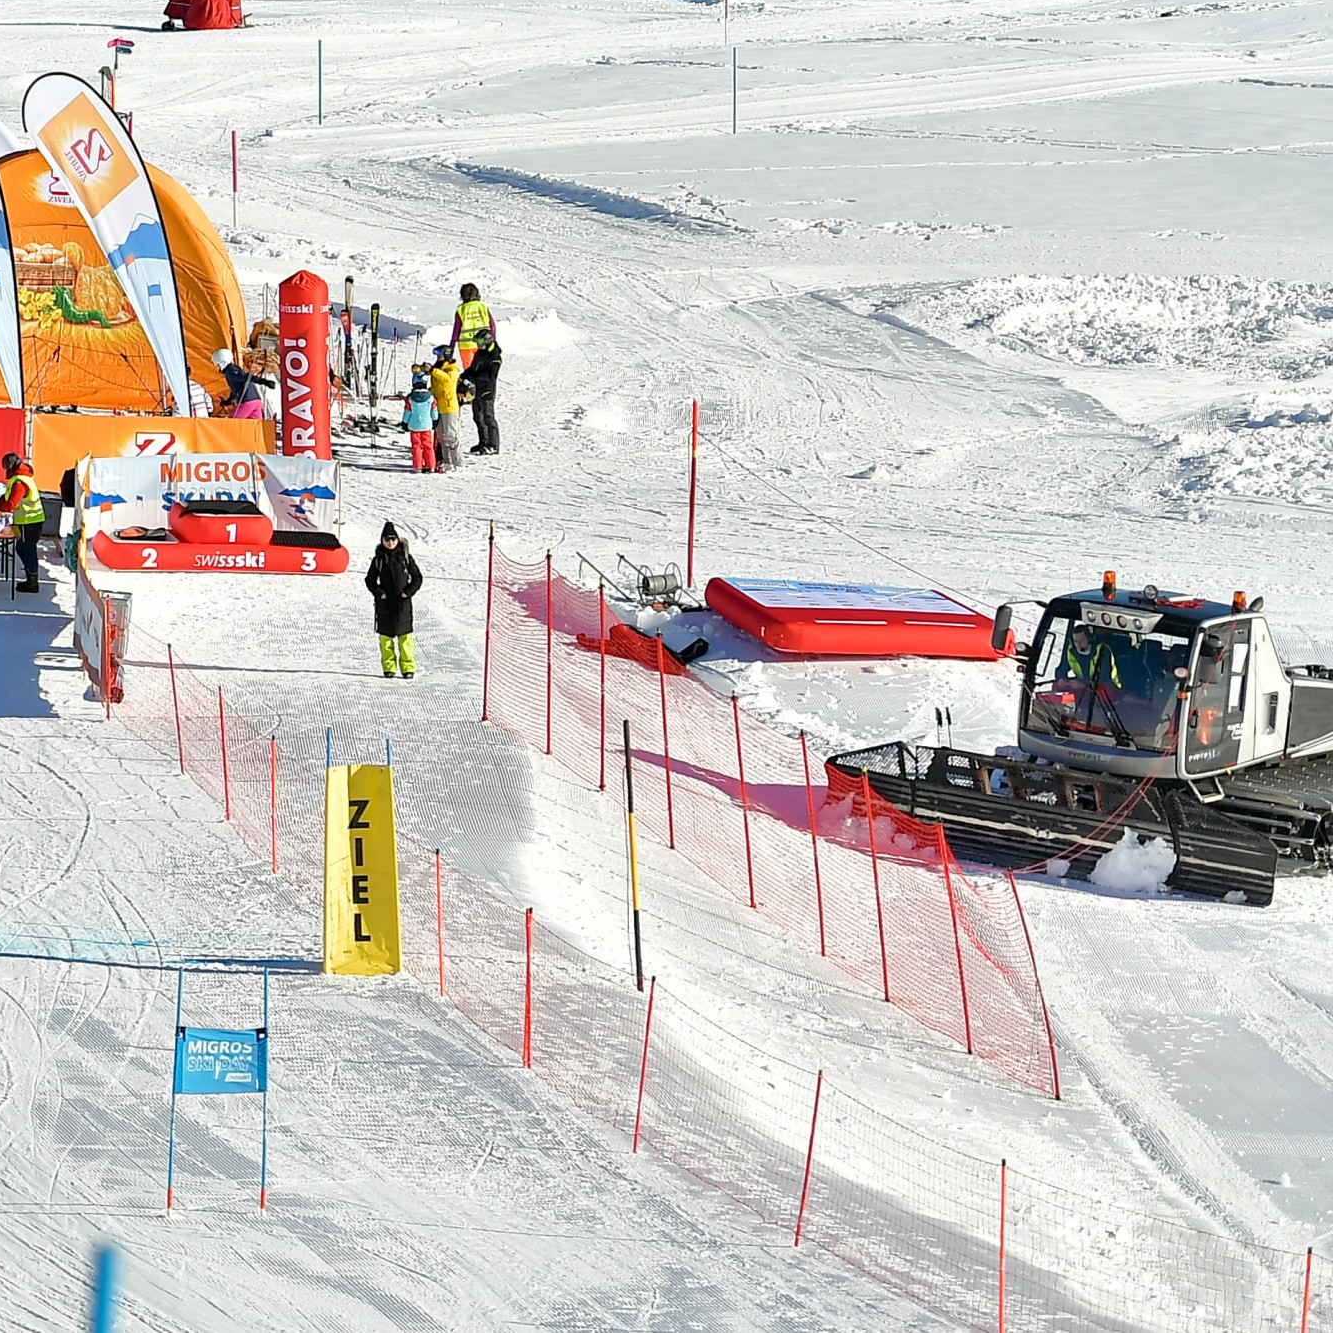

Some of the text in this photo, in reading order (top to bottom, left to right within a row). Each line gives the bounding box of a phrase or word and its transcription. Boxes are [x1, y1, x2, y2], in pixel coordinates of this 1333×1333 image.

[160, 461, 267, 483] MIGROS
[225, 523, 237, 543] 1
[141, 547, 158, 568] 2
[194, 551, 266, 568] swissski
[300, 552, 317, 571] 3
[1188, 751, 1216, 762] everest
[348, 800, 371, 942] ZIEL
[188, 1041, 253, 1054] MIGROS
[187, 1055, 253, 1072] SKI DAY
